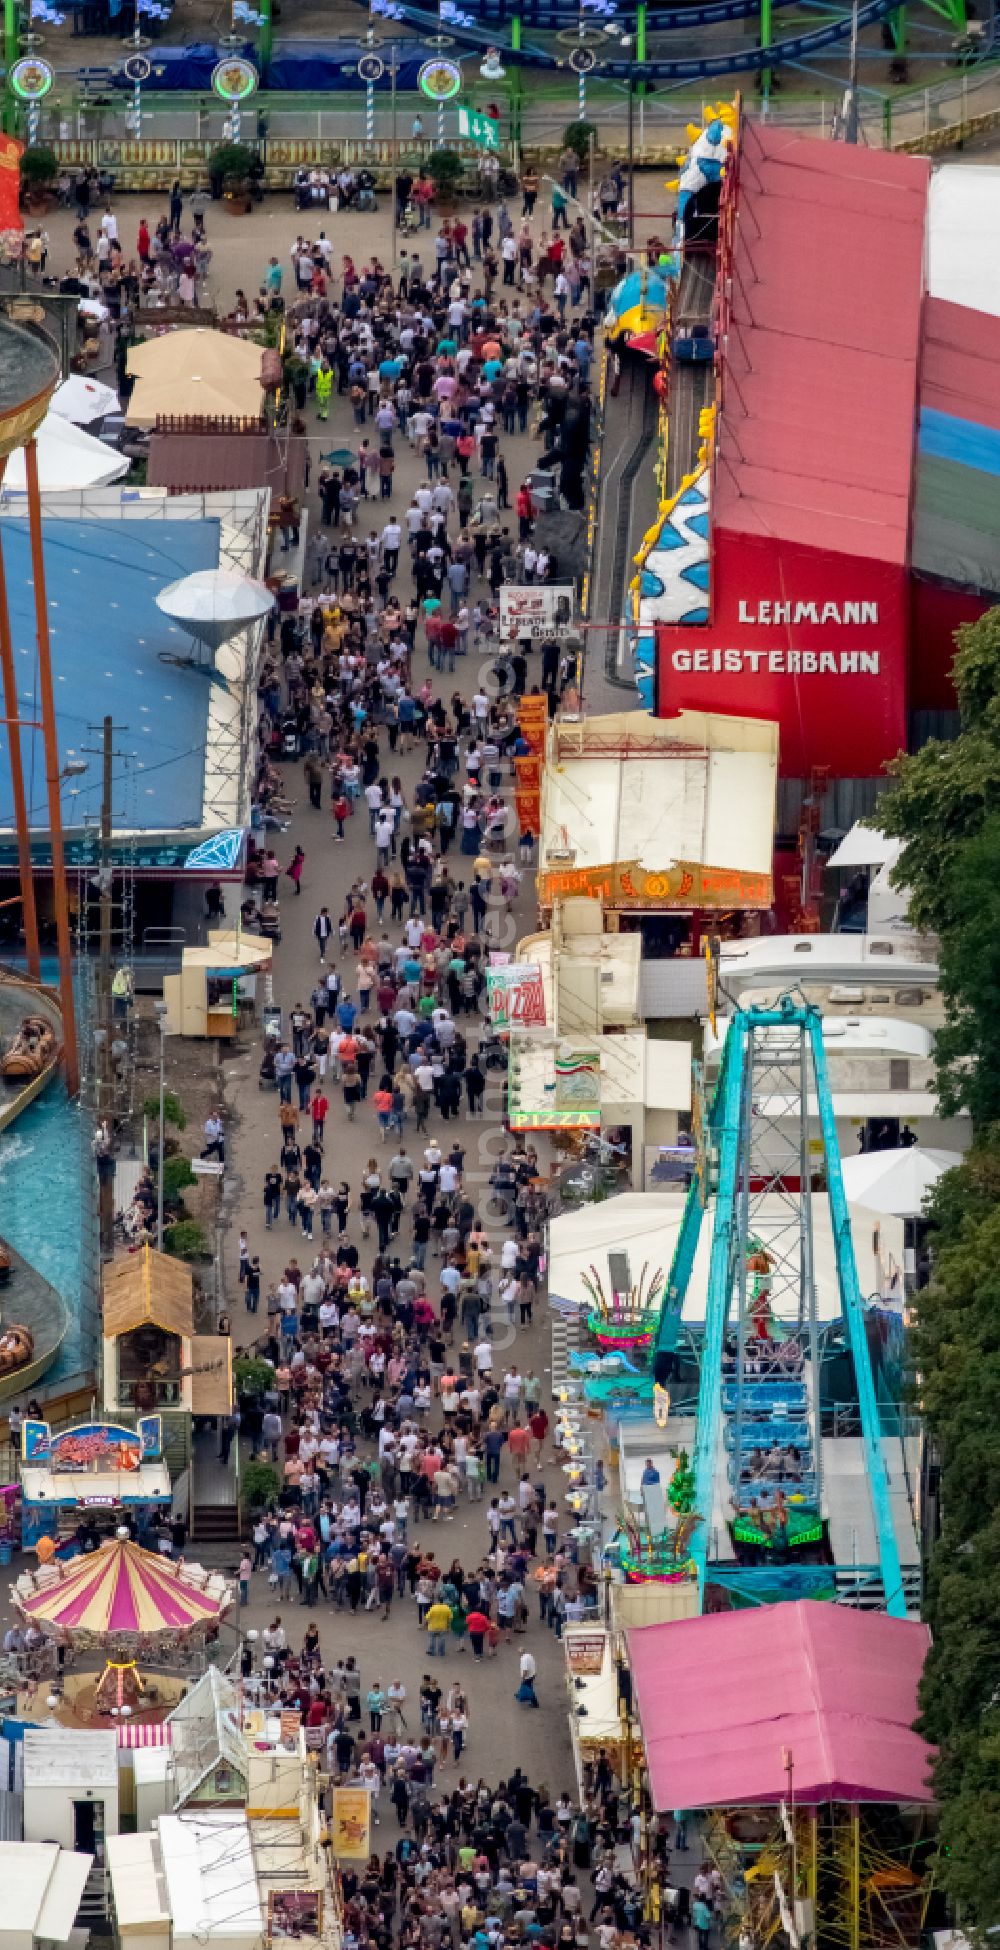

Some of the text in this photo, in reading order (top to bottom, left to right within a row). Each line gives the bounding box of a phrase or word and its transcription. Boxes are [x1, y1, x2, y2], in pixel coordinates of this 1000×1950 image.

[738, 600, 879, 625] LEHMANN
[671, 649, 880, 674] GEISTERBAHN
[515, 1114, 592, 1127] PIZZA
